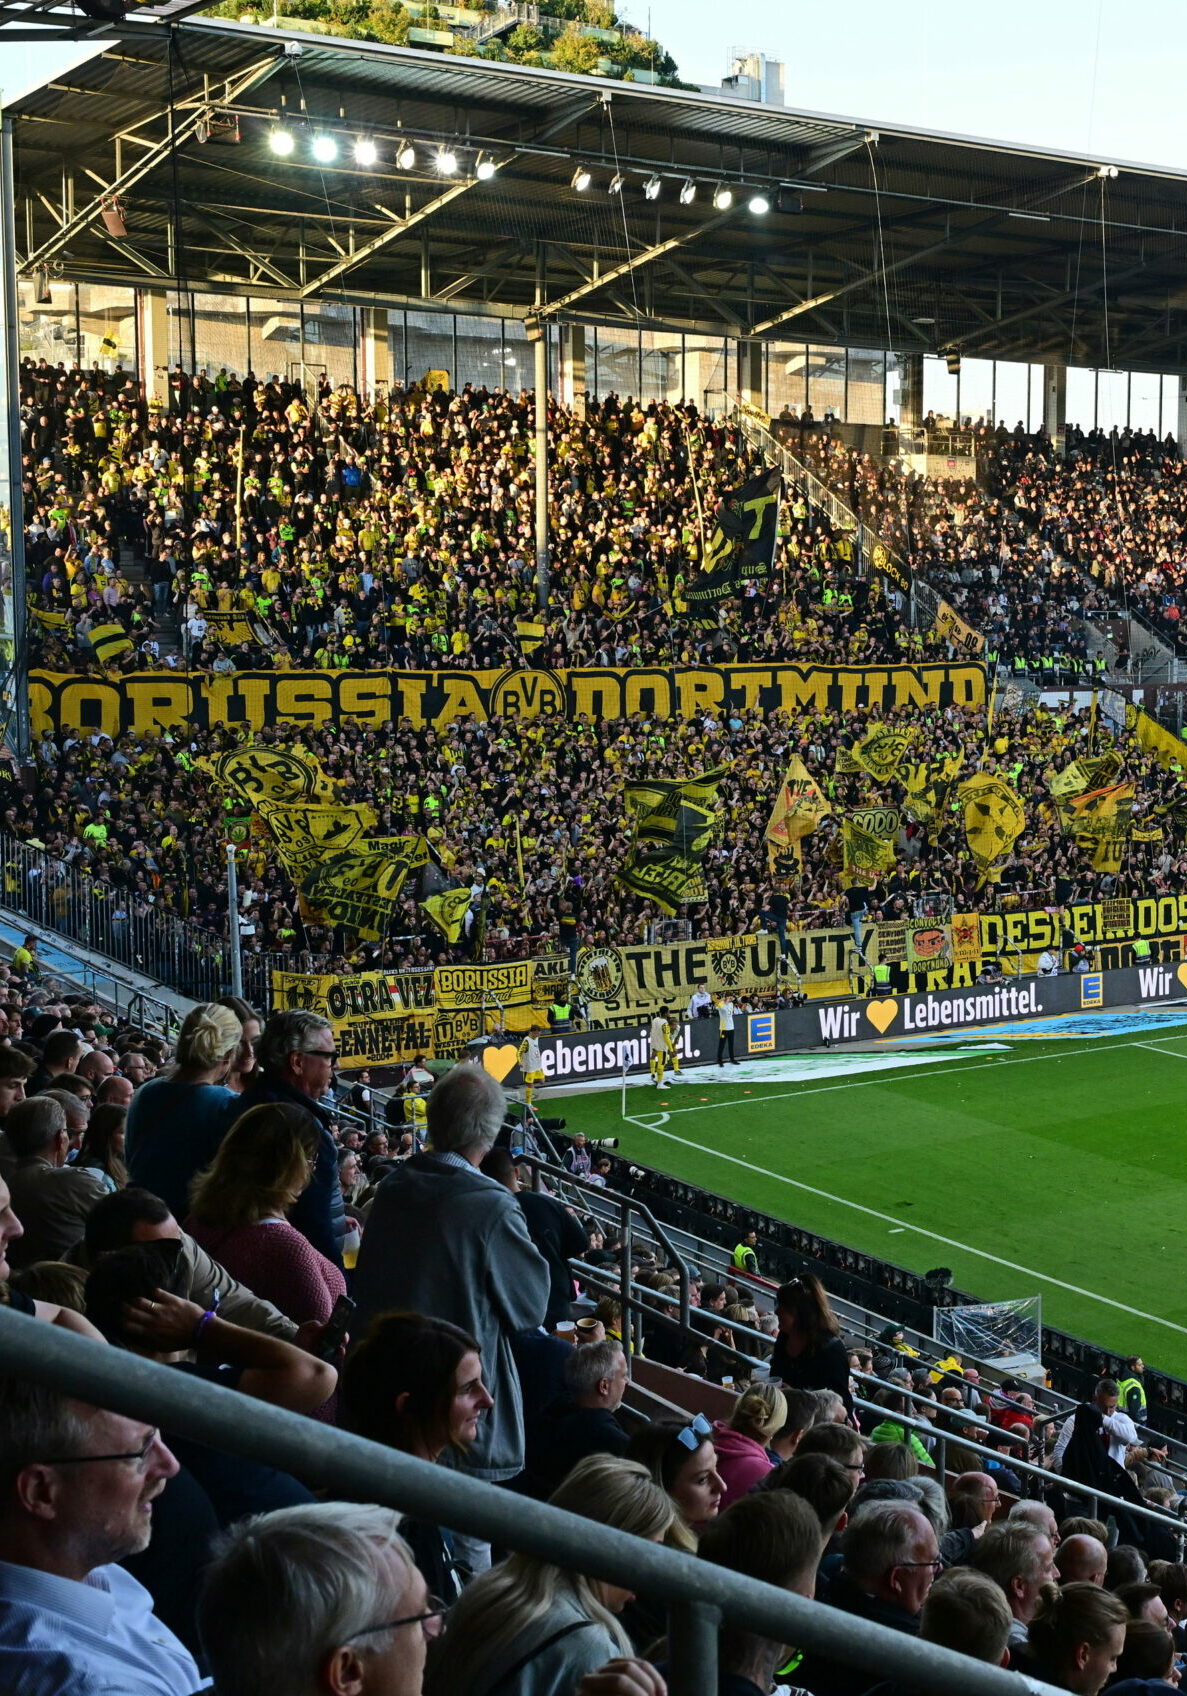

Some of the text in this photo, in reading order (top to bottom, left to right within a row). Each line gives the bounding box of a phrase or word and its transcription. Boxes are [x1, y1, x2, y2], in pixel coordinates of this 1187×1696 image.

[29, 667, 986, 739] BORUSSIA BVB DORTMUND
[625, 946, 709, 989] THE
[750, 928, 875, 978] UNITY
[722, 956, 737, 969] BVB
[912, 957, 951, 973] DORTMUND
[438, 963, 529, 994] BORUSSIA
[1137, 966, 1173, 998] Wir
[326, 974, 435, 1020] OTRA VEZ
[818, 982, 1044, 1040] Wir Lebensmittel.
[1083, 999, 1102, 1007] EDEKA
[455, 1012, 478, 1032] BVB
[750, 1041, 774, 1050] EDEKA
